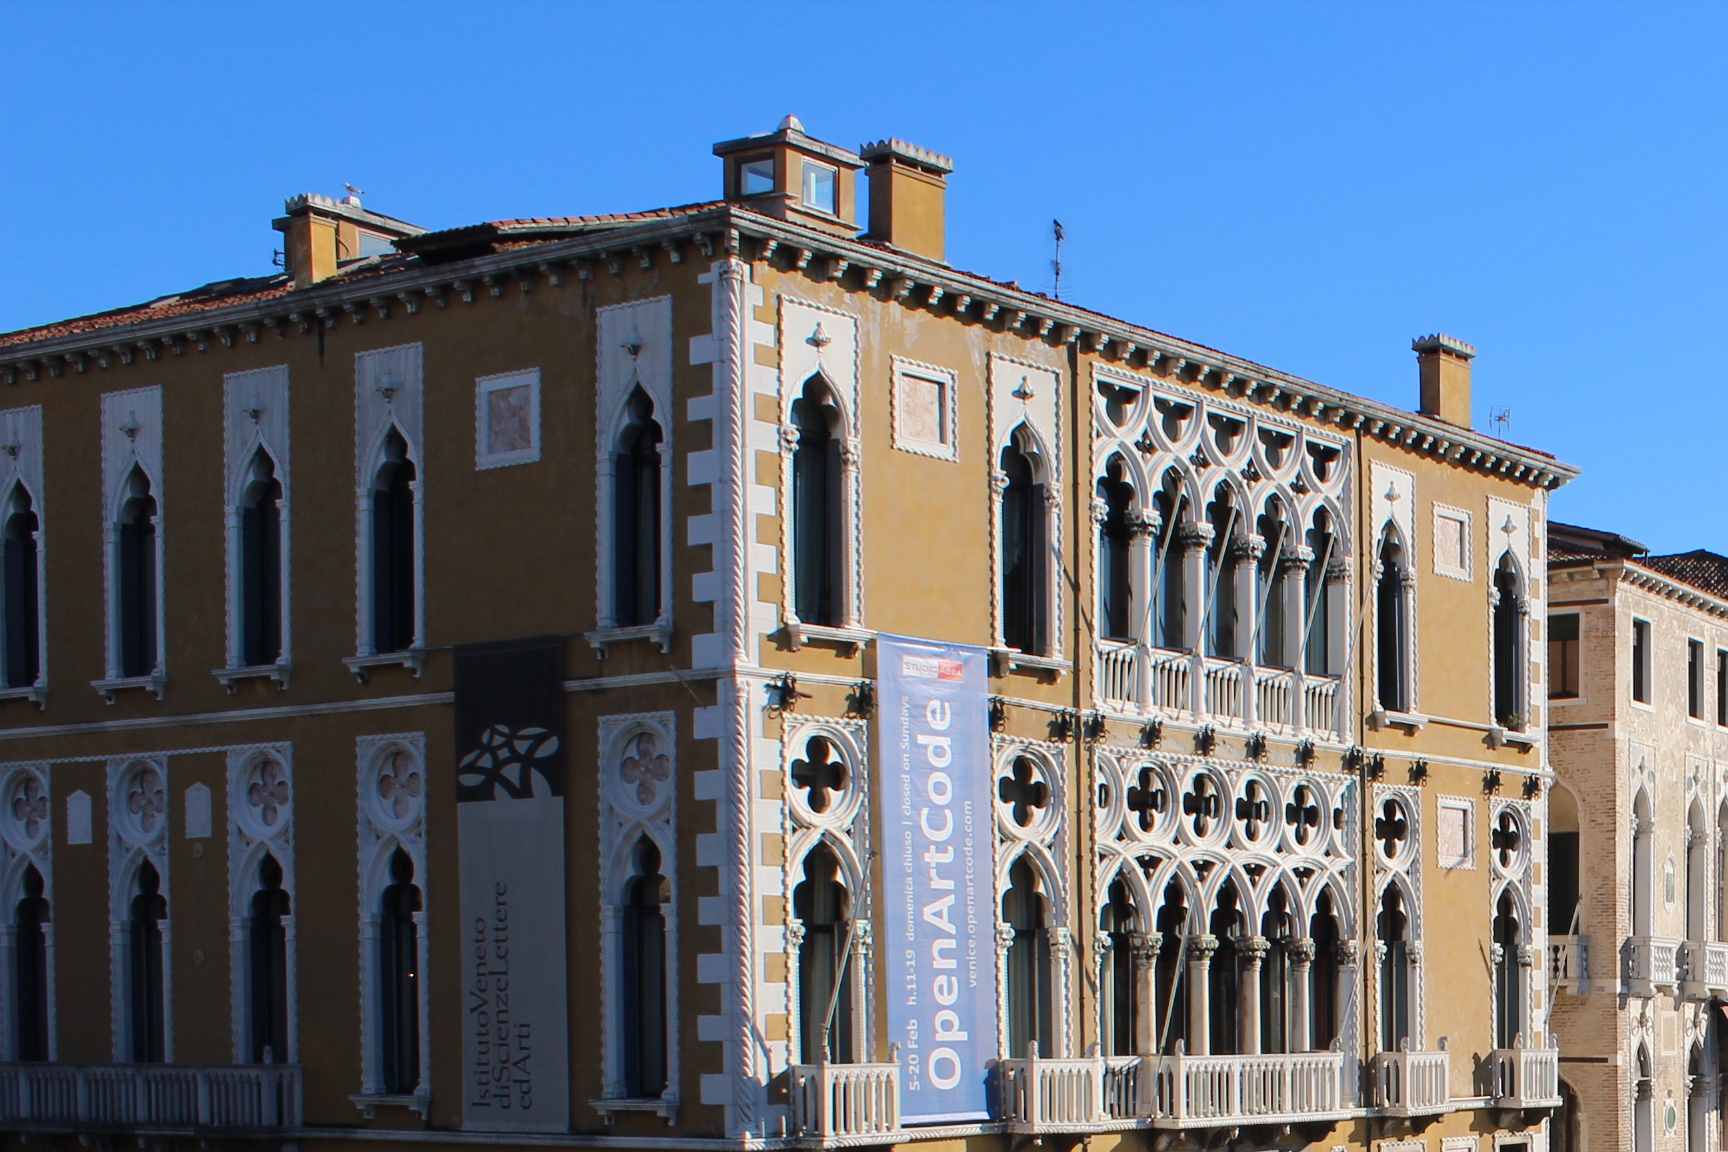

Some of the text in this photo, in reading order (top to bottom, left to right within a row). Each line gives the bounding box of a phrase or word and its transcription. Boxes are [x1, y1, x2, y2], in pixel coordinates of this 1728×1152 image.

[904, 661, 962, 677] STUDIO ABBA
[900, 695, 911, 751] Sundays
[902, 753, 911, 770] on
[901, 774, 911, 816] closed
[903, 831, 913, 873] chiuso
[904, 877, 915, 941] domenica
[917, 699, 968, 1090] OpenArtCode
[962, 800, 978, 988] venice.openartcode.com
[488, 881, 512, 1110] diScienzeLettere
[905, 949, 917, 1006] h.11-19
[469, 917, 492, 1108] IstitutoVeneto
[907, 1019, 918, 1049] Feb
[511, 1022, 532, 1111] edArti
[908, 1054, 920, 1091] 5-20
